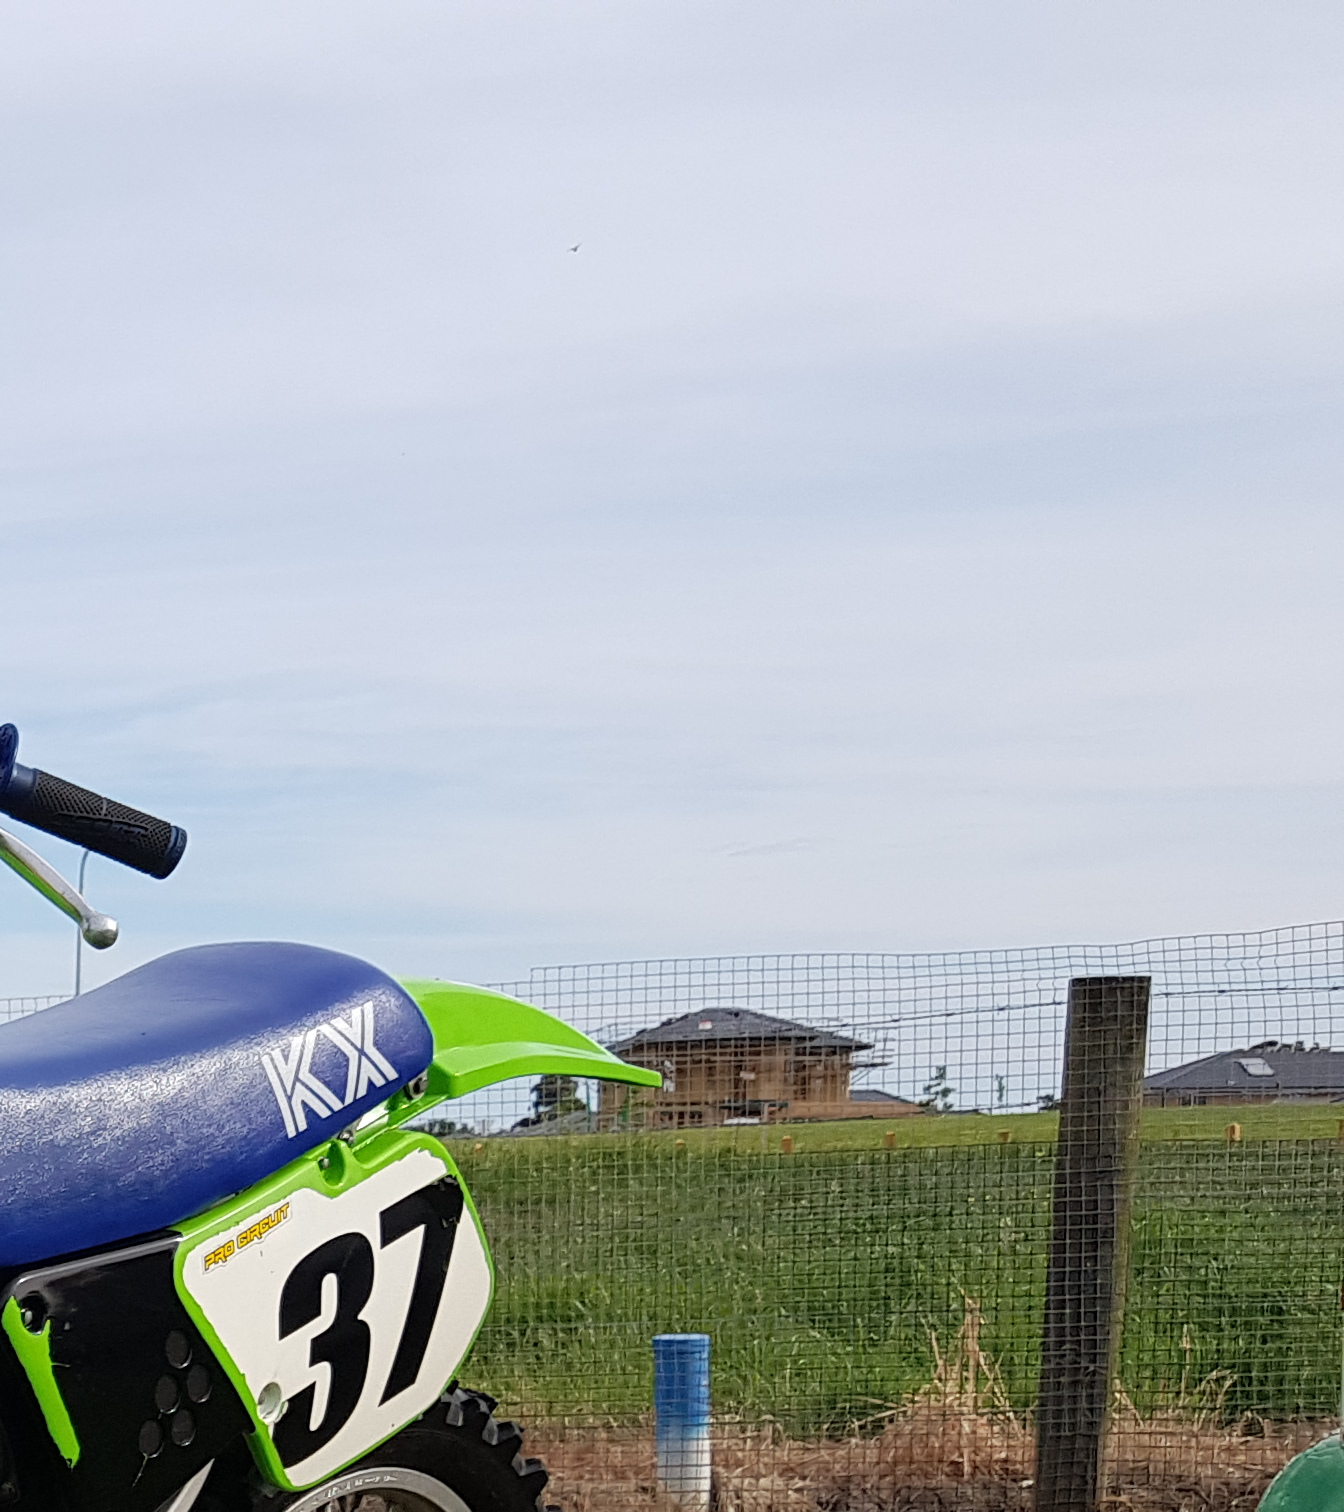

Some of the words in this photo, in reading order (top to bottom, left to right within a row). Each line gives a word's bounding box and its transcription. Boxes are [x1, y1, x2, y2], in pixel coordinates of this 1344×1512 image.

[260, 1001, 399, 1139] KX
[204, 1239, 235, 1271] PRO
[236, 1202, 290, 1249] CIRCUIT
[269, 1174, 465, 1468] 37
